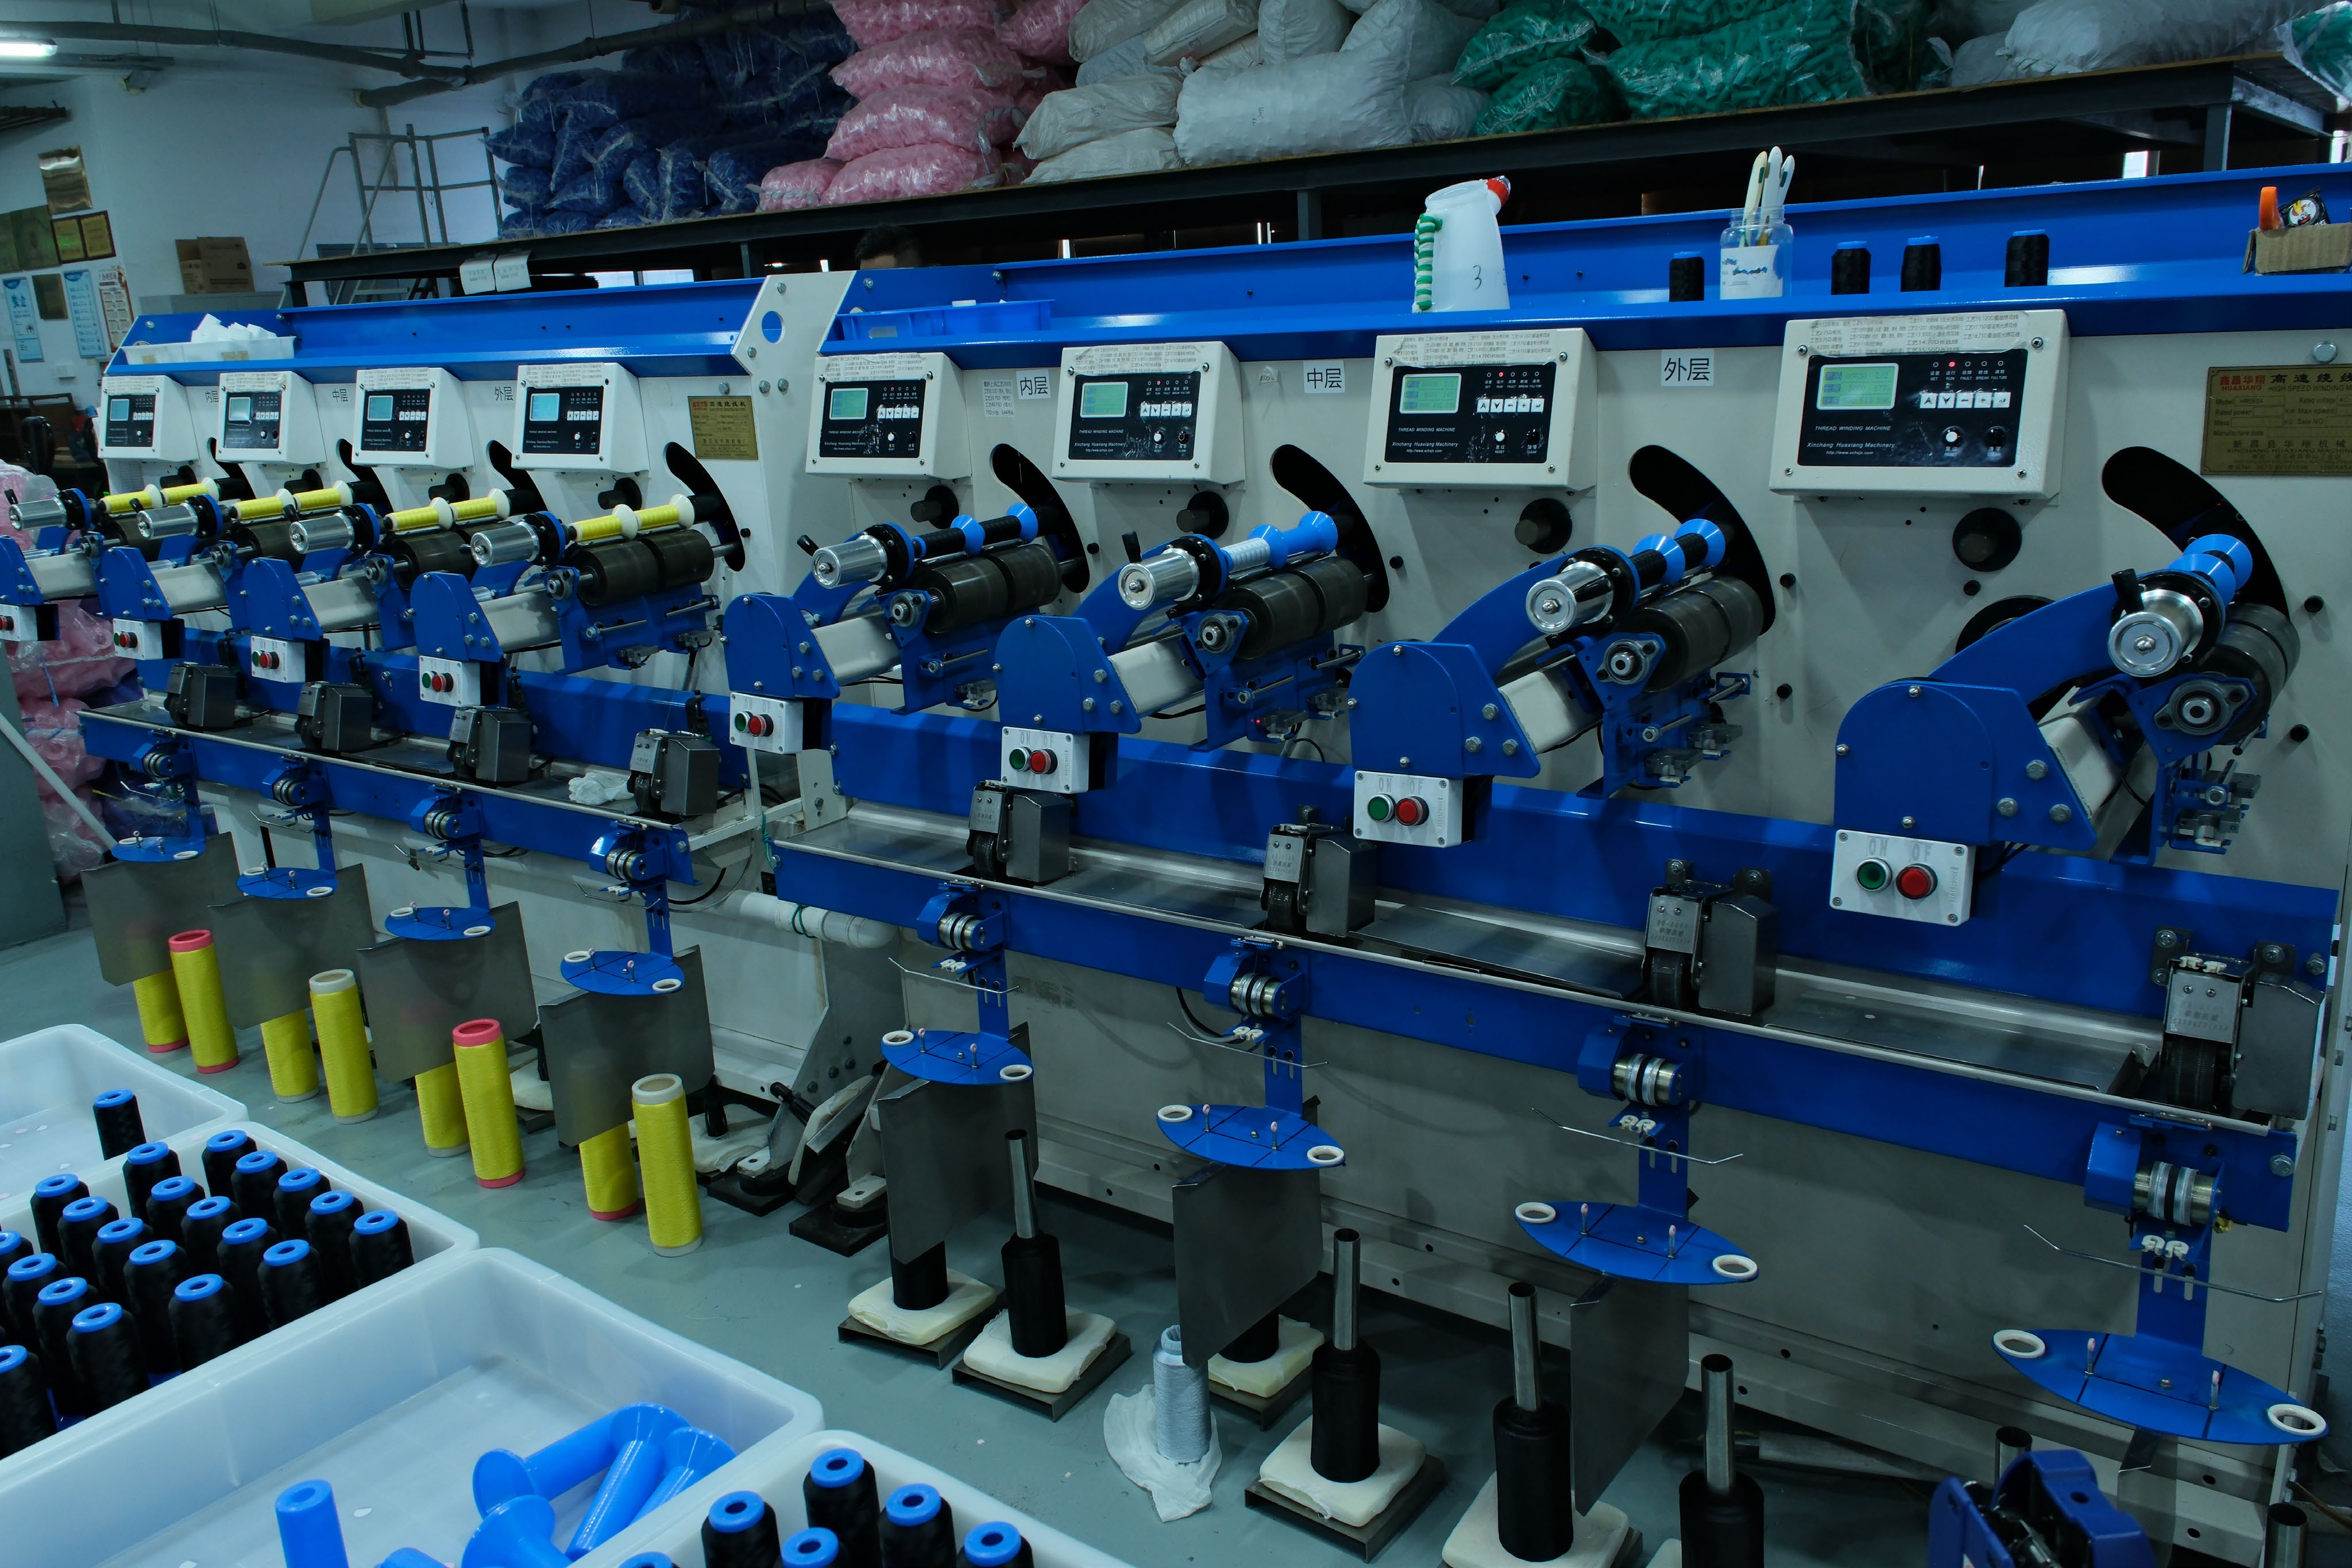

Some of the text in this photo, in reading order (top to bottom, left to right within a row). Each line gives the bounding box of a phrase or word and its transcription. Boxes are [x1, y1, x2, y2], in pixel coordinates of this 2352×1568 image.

[1472, 264, 1482, 290] 3
[1307, 368, 1342, 389] 中层
[1664, 358, 1710, 381] 外层
[495, 386, 514, 401] 外层
[1019, 377, 1049, 396] 内层
[205, 391, 219, 403] 内层
[332, 389, 349, 403] 中层
[1379, 777, 1392, 793] ON
[1869, 839, 1888, 857] ON
